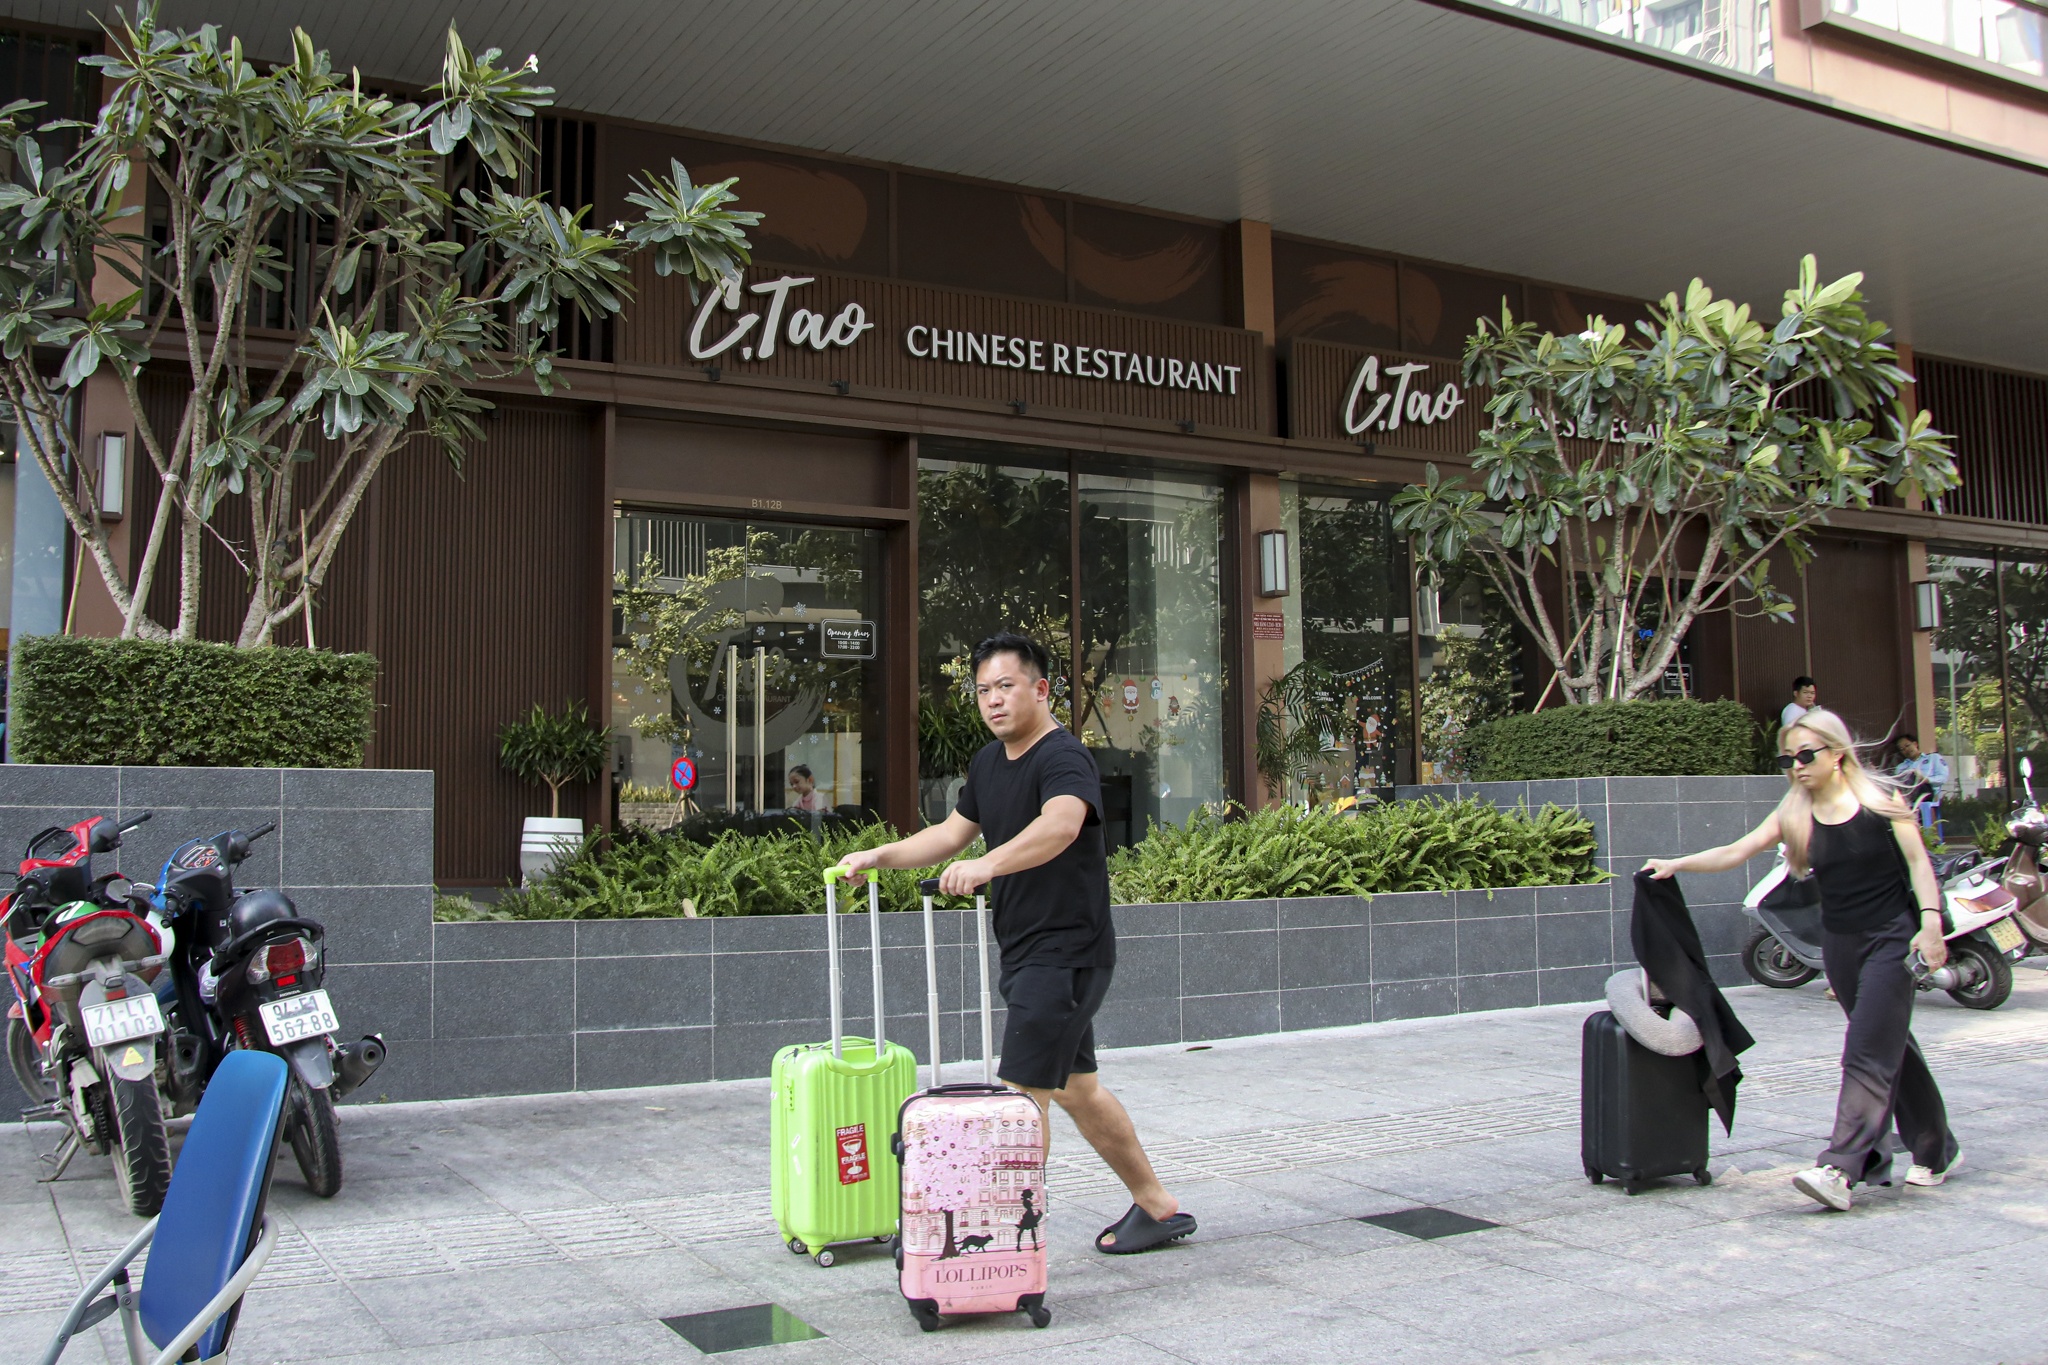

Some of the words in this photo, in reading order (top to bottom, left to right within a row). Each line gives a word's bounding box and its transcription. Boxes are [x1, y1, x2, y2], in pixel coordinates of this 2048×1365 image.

[690, 267, 875, 360] C.Tao
[906, 325, 1046, 373] CHINESE
[1052, 344, 1241, 395] RESTAURANT
[1345, 355, 1465, 435] C.Tao
[751, 498, 783, 510] B1.12B
[826, 628, 852, 639] Opening
[853, 628, 871, 638] Hours
[94, 999, 147, 1024] 71-L1
[94, 1015, 157, 1042] 011.03
[272, 1012, 334, 1042] 562.88
[836, 1124, 864, 1137] FRAGILE
[936, 1263, 1028, 1284] LOLLIPOPS
